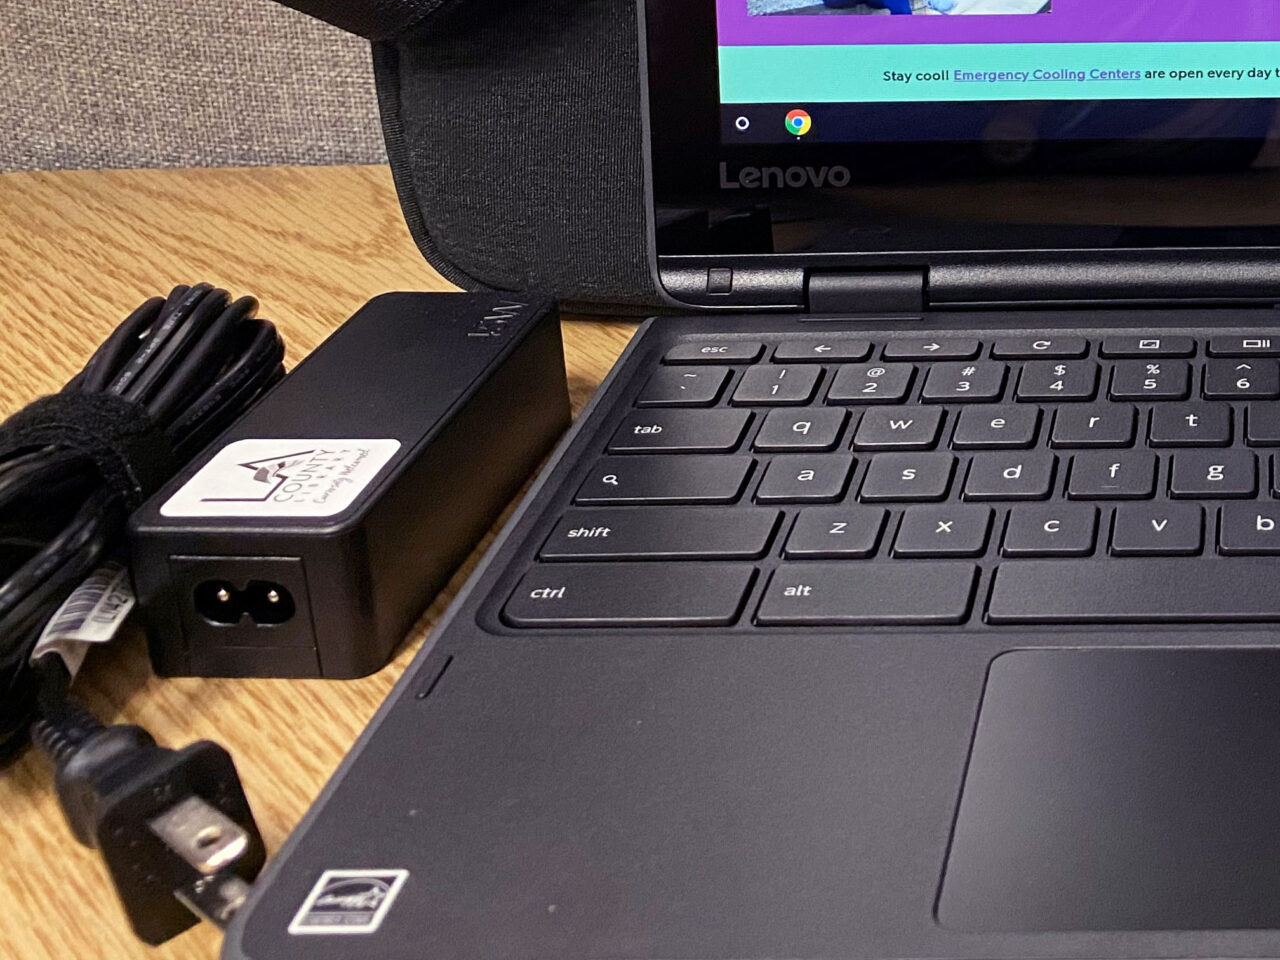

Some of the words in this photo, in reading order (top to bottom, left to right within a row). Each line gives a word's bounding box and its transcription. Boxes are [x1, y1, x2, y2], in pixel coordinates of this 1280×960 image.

[883, 70, 913, 84] Stay
[954, 69, 1029, 83] Emergency
[1032, 68, 1085, 82] Cooling
[1089, 68, 1141, 81] Centers
[1144, 70, 1166, 79] are
[1168, 70, 1204, 81] open
[1207, 69, 1245, 81] every
[1247, 67, 1272, 81] day
[719, 161, 851, 189] Lenovo
[700, 344, 728, 354] esc
[888, 418, 914, 430] w
[990, 417, 1006, 428] e
[1088, 416, 1101, 429] r
[1185, 413, 1199, 428] t
[633, 423, 663, 435] tab
[792, 420, 812, 435] q
[567, 526, 611, 538] shift
[530, 586, 566, 600] ctrl
[783, 585, 812, 597] alt
